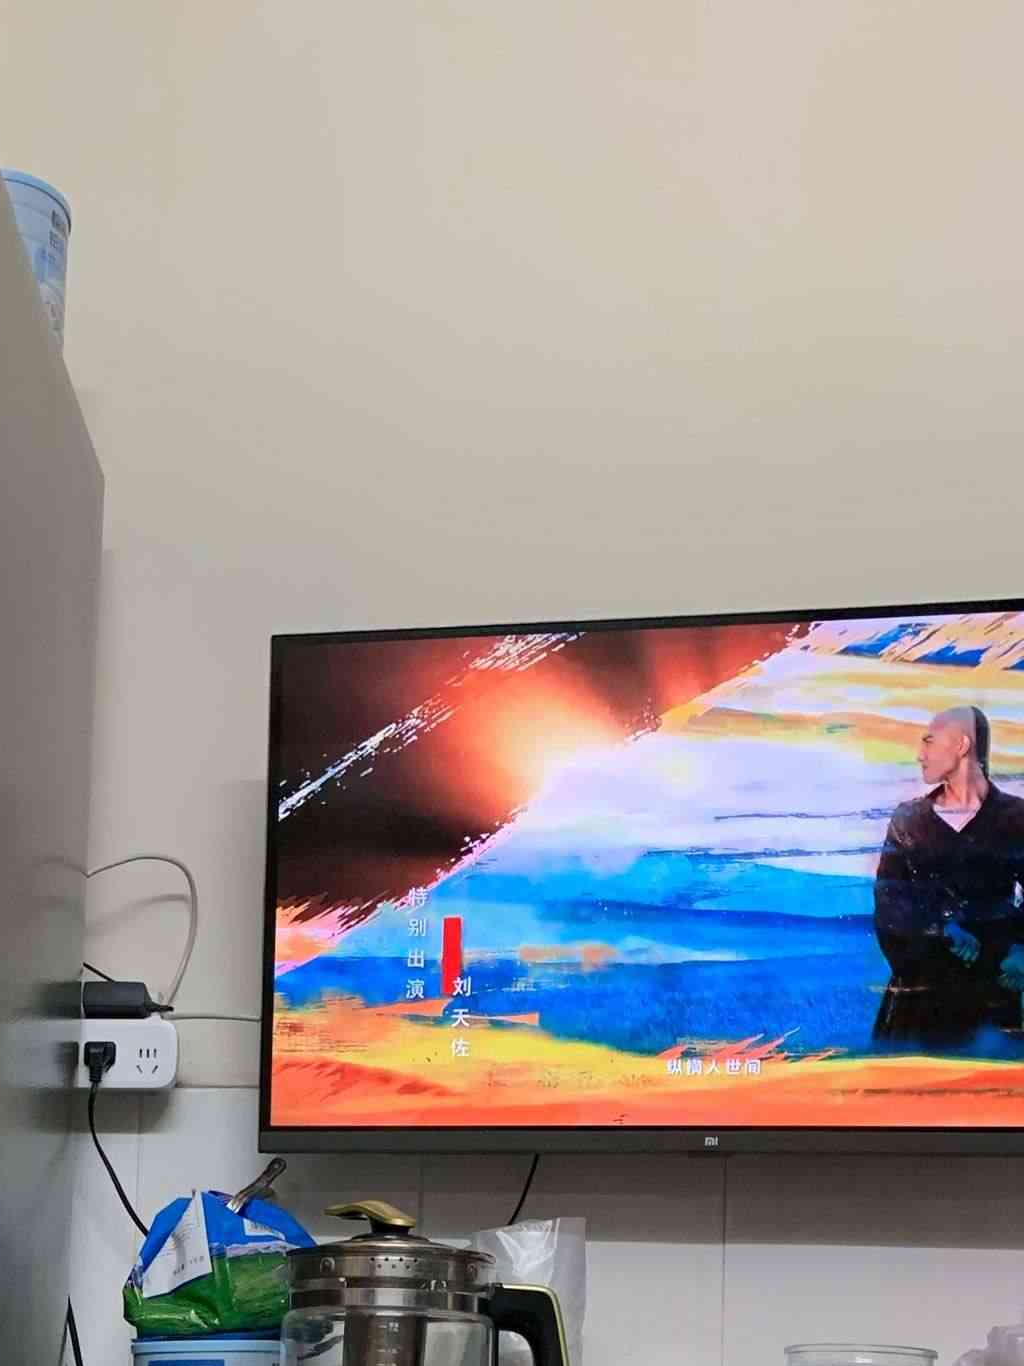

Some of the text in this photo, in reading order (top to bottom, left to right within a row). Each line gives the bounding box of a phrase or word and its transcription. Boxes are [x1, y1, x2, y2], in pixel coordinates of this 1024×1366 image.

[405, 887, 428, 999] 特别出演
[451, 976, 472, 1057] 刘天佐
